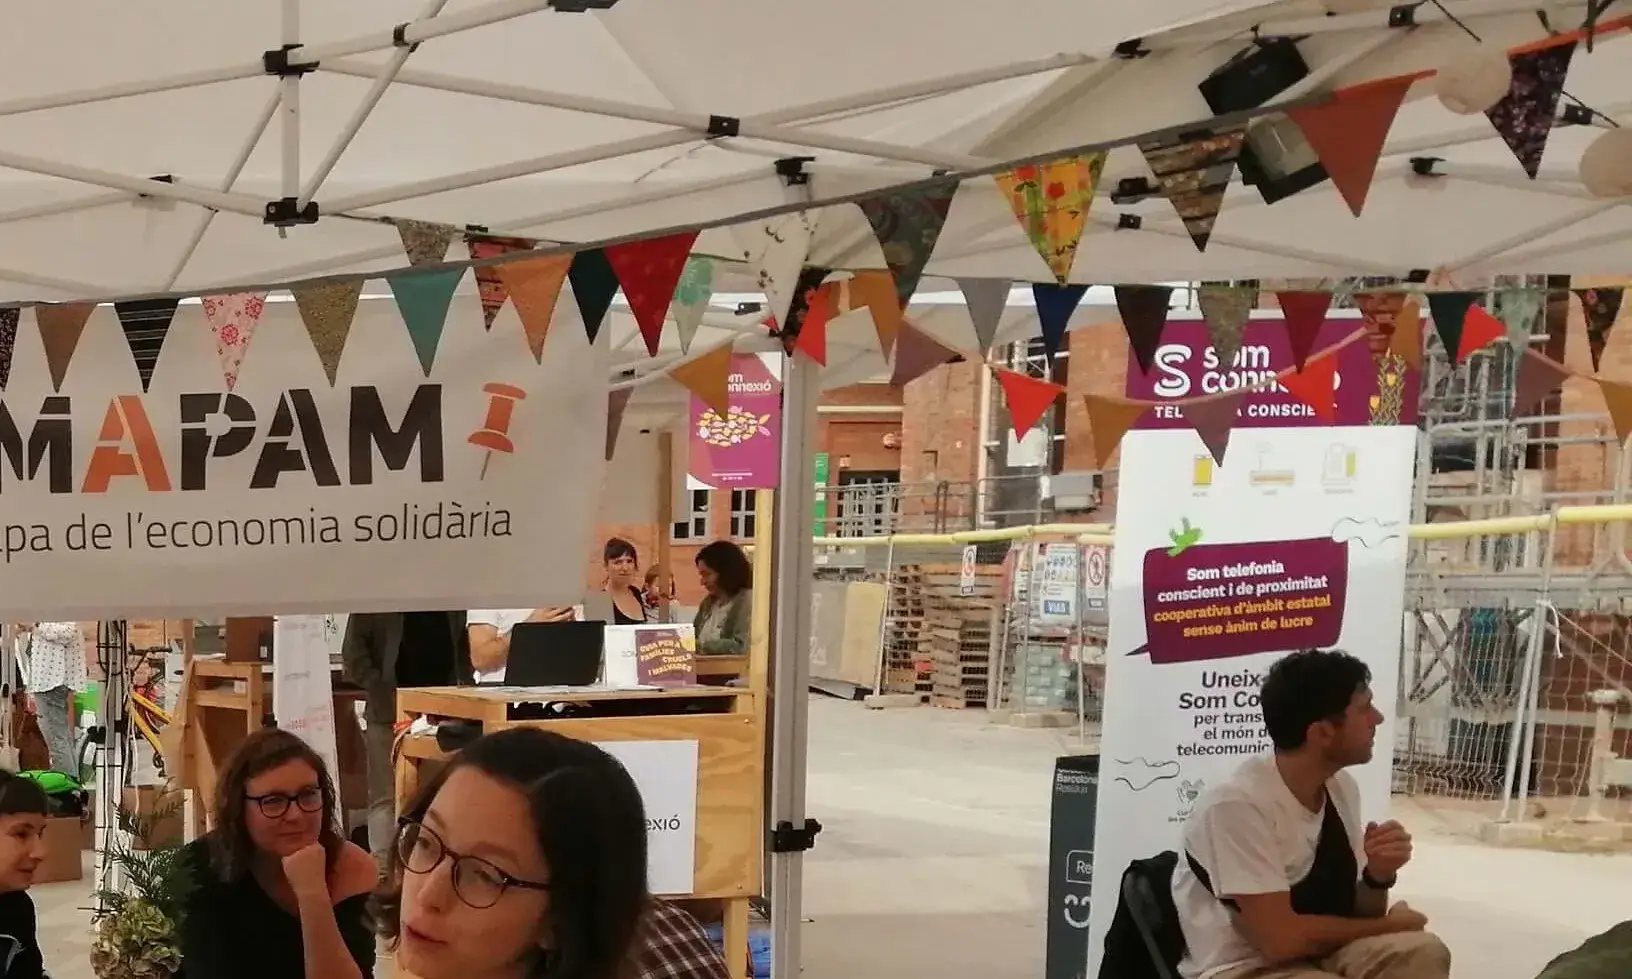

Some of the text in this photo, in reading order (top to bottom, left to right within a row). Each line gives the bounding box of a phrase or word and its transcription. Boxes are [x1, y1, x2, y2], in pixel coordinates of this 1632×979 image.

[728, 379, 772, 392] nnexió
[1248, 403, 1337, 417] CONSCIE
[65, 512, 112, 551] de
[127, 507, 342, 549] l'economia
[354, 501, 512, 542] solidària
[1187, 560, 1285, 581] Som telefonia
[1157, 585, 1226, 602] conscient
[1235, 581, 1254, 596] de
[1256, 575, 1329, 597] proximitat
[1153, 604, 1232, 622] cooperativa
[1286, 594, 1331, 609] estatal
[1261, 617, 1278, 630] de
[1280, 615, 1314, 628] lucre
[1178, 692, 1227, 709] Som
[1194, 714, 1219, 728] per
[1204, 727, 1217, 740] el
[1221, 725, 1254, 740] món
[645, 813, 681, 831] exió
